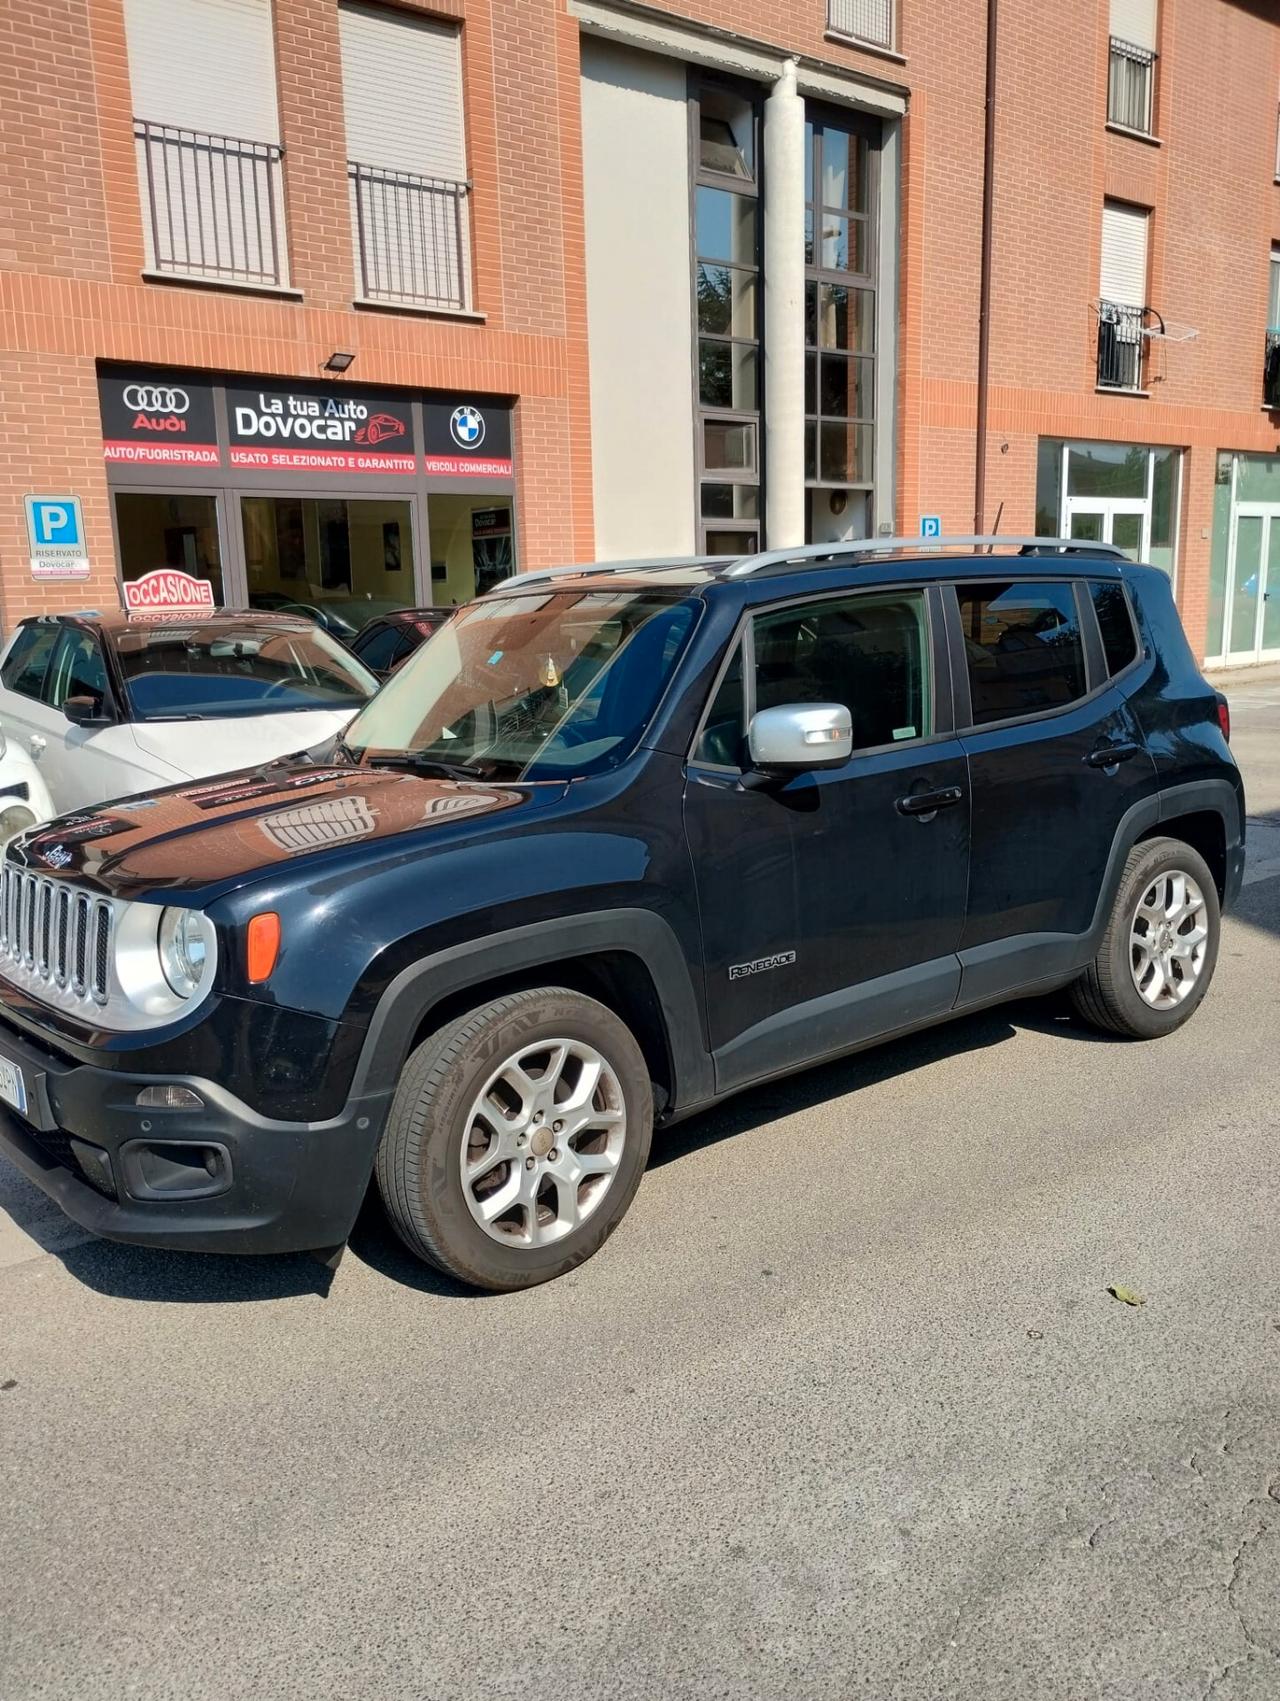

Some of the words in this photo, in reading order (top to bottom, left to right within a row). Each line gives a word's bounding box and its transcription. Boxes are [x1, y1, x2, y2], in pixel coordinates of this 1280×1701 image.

[259, 393, 283, 414] La
[288, 395, 320, 417] tua
[324, 399, 368, 419] Auto
[132, 413, 187, 432] Audi
[235, 407, 356, 441] Dovocar
[103, 446, 219, 462] AUTO/FUORISTRADA
[230, 452, 269, 464] USATO
[271, 454, 345, 467] SELEZIONATO
[347, 457, 356, 468] E
[357, 458, 415, 470] GARANTITO
[426, 461, 458, 472] VEICOLI
[458, 463, 512, 475] COMMERCIALI
[40, 506, 68, 540] P
[39, 560, 75, 568] Dovocar
[129, 575, 211, 604] OCCASIONE
[729, 951, 796, 980] RENEGADE
